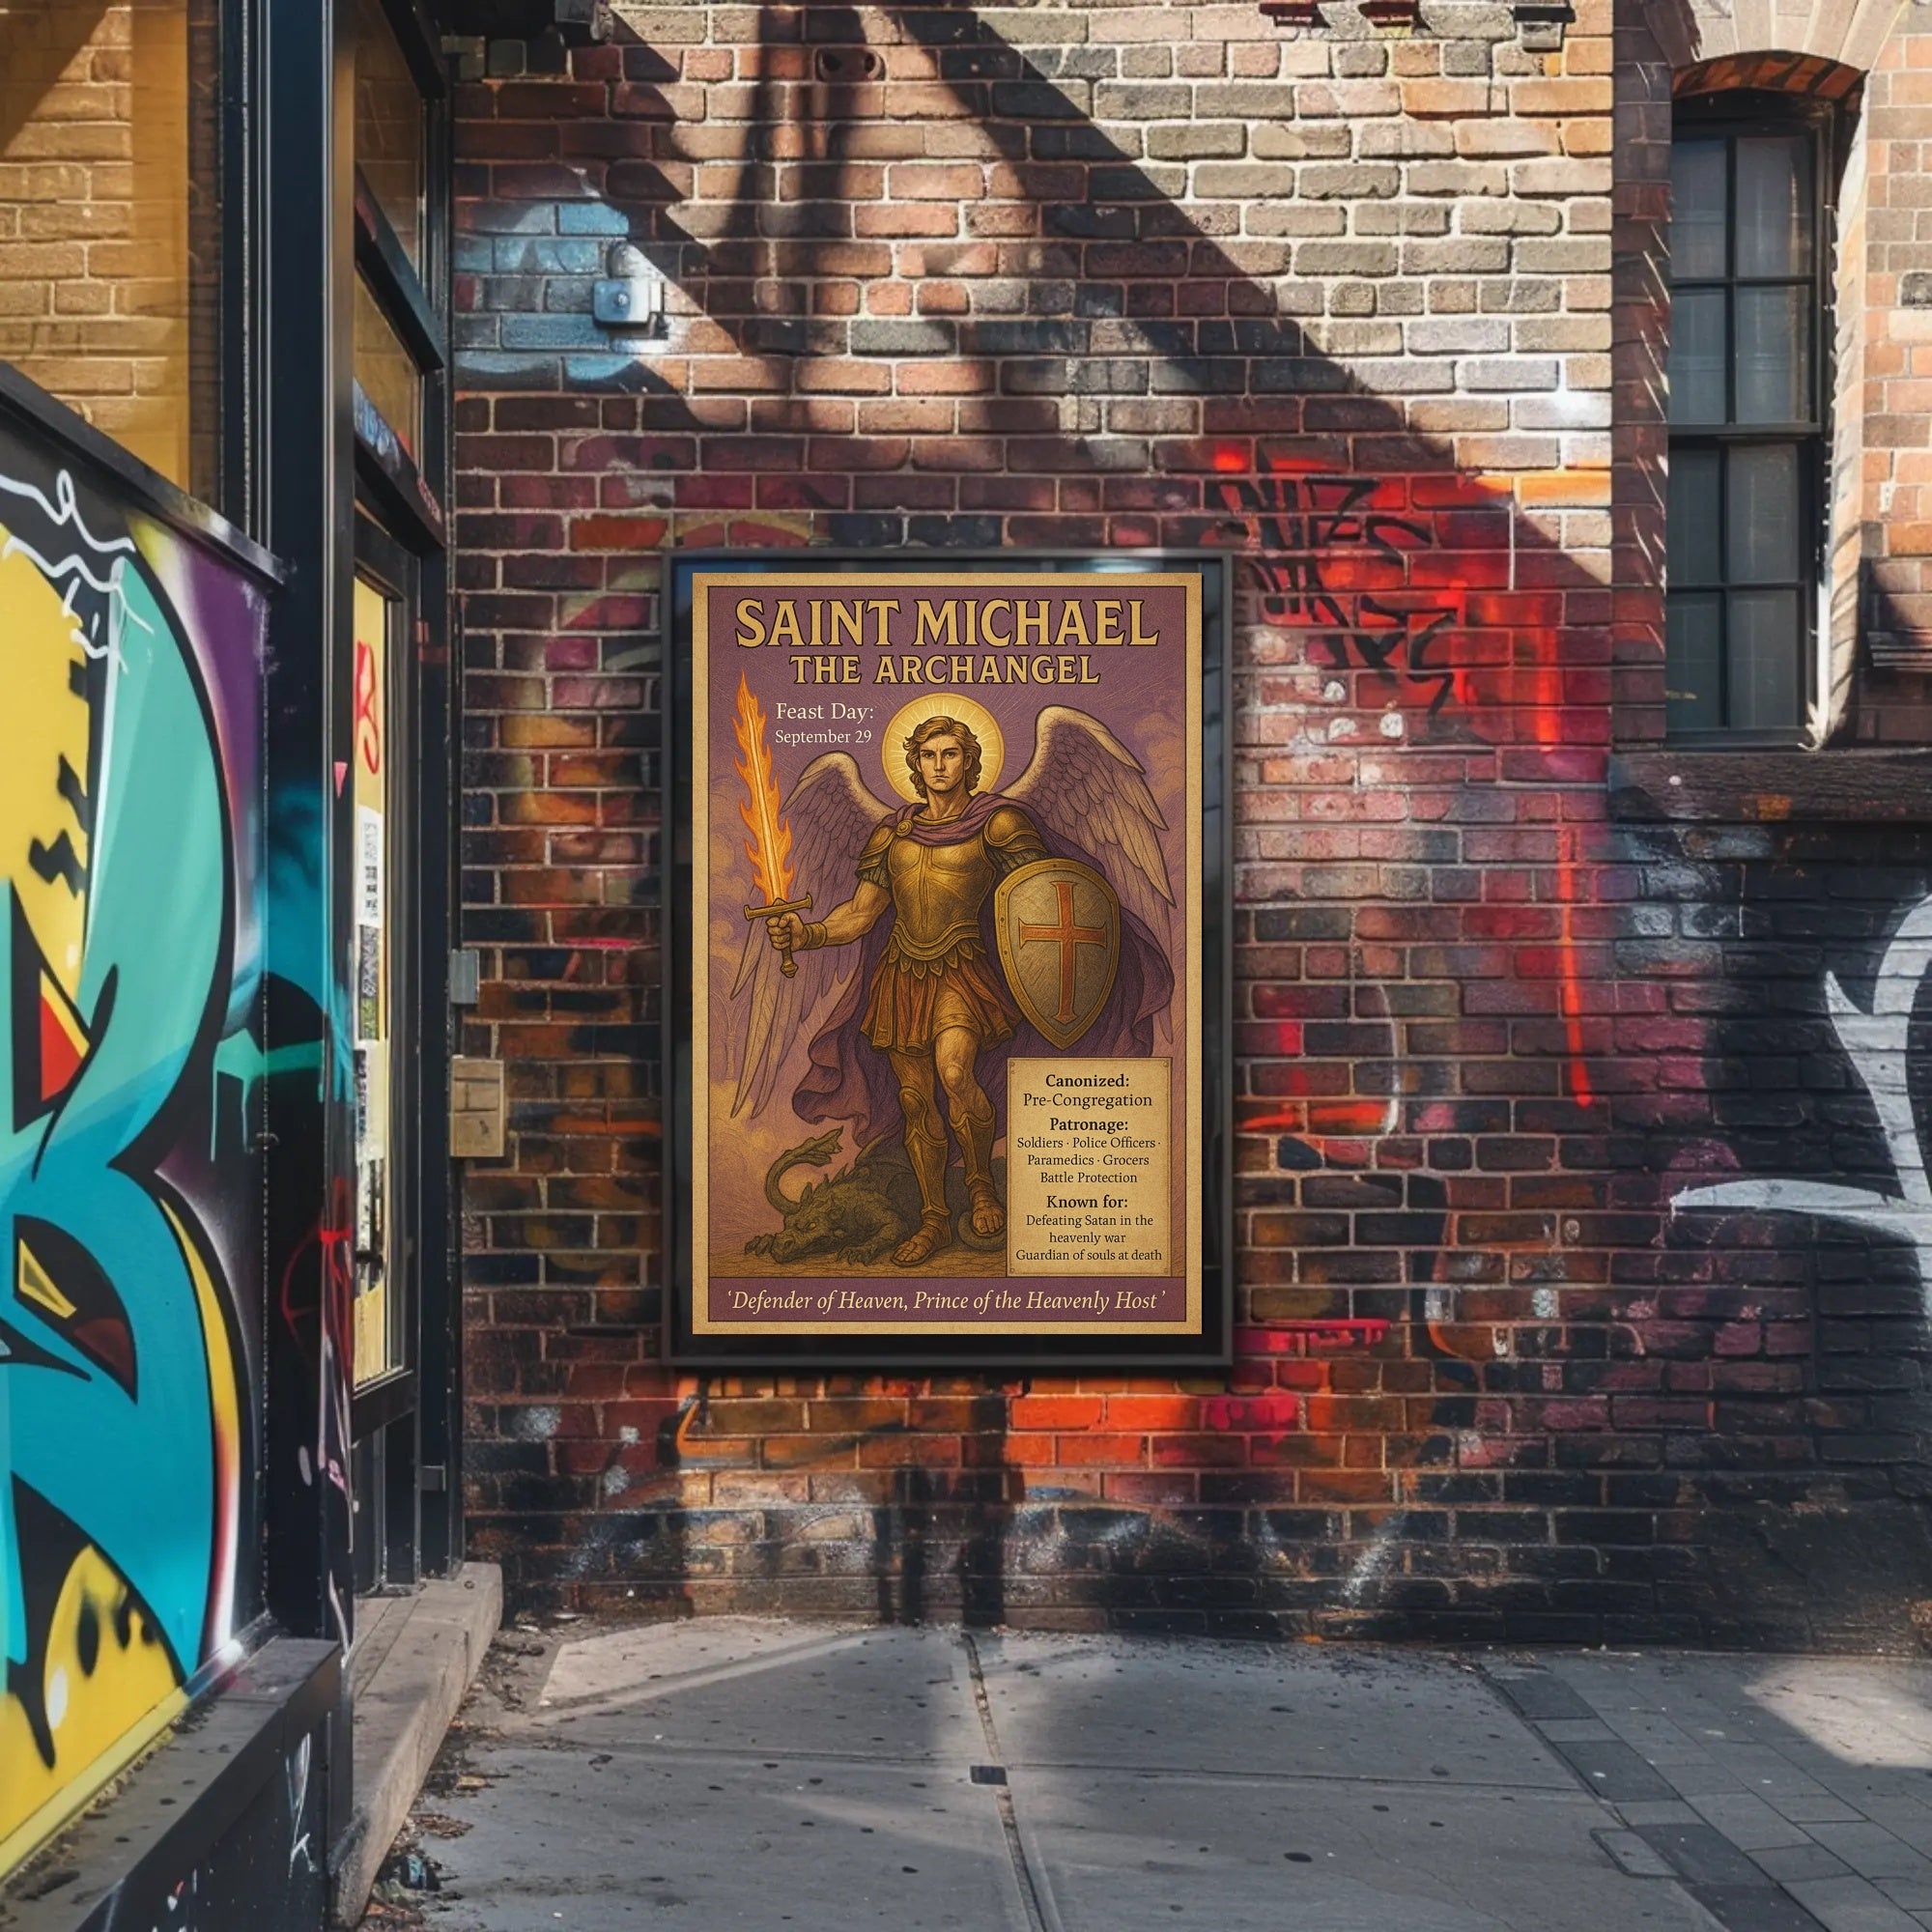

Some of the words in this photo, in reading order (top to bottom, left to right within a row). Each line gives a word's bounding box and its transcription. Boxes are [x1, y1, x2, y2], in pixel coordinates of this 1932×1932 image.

[734, 599, 901, 648] SAINT
[913, 598, 1160, 647] MICHAEL
[789, 655, 863, 685] THE
[873, 655, 1101, 685] ARCHANGEL
[776, 702, 825, 720] Feast
[831, 702, 874, 724] Day:
[775, 729, 851, 746] September
[855, 730, 872, 744] 29
[1045, 1074, 1129, 1088] Canonized:
[1023, 1094, 1152, 1109] Pre-Congregation
[1050, 1118, 1128, 1133] Patronage:
[1017, 1137, 1064, 1149] Soldiers
[1073, 1137, 1107, 1149] Police
[1111, 1136, 1155, 1149] Officers
[1028, 1154, 1094, 1166] Paramedics
[1103, 1154, 1150, 1166] Grocers
[1040, 1172, 1073, 1183] Battle
[1078, 1172, 1137, 1183] Protection
[1046, 1195, 1098, 1208] Known
[1103, 1195, 1128, 1208] for:
[1026, 1214, 1082, 1228] Defeating
[1085, 1215, 1117, 1226] Satan
[1121, 1215, 1131, 1226] in
[1135, 1214, 1153, 1226] the
[1049, 1233, 1101, 1245] heavenly
[1015, 1249, 1069, 1261] Guardian
[1072, 1249, 1085, 1261] of
[1087, 1249, 1115, 1261] souls
[1119, 1251, 1128, 1261] at
[1131, 1249, 1162, 1261] death
[817, 1290, 838, 1315] of
[838, 1292, 909, 1313] Heaven,
[913, 1291, 968, 1310] Prince
[973, 1290, 993, 1315] of
[995, 1291, 1022, 1310] the
[1026, 1291, 1110, 1315] Heavenly
